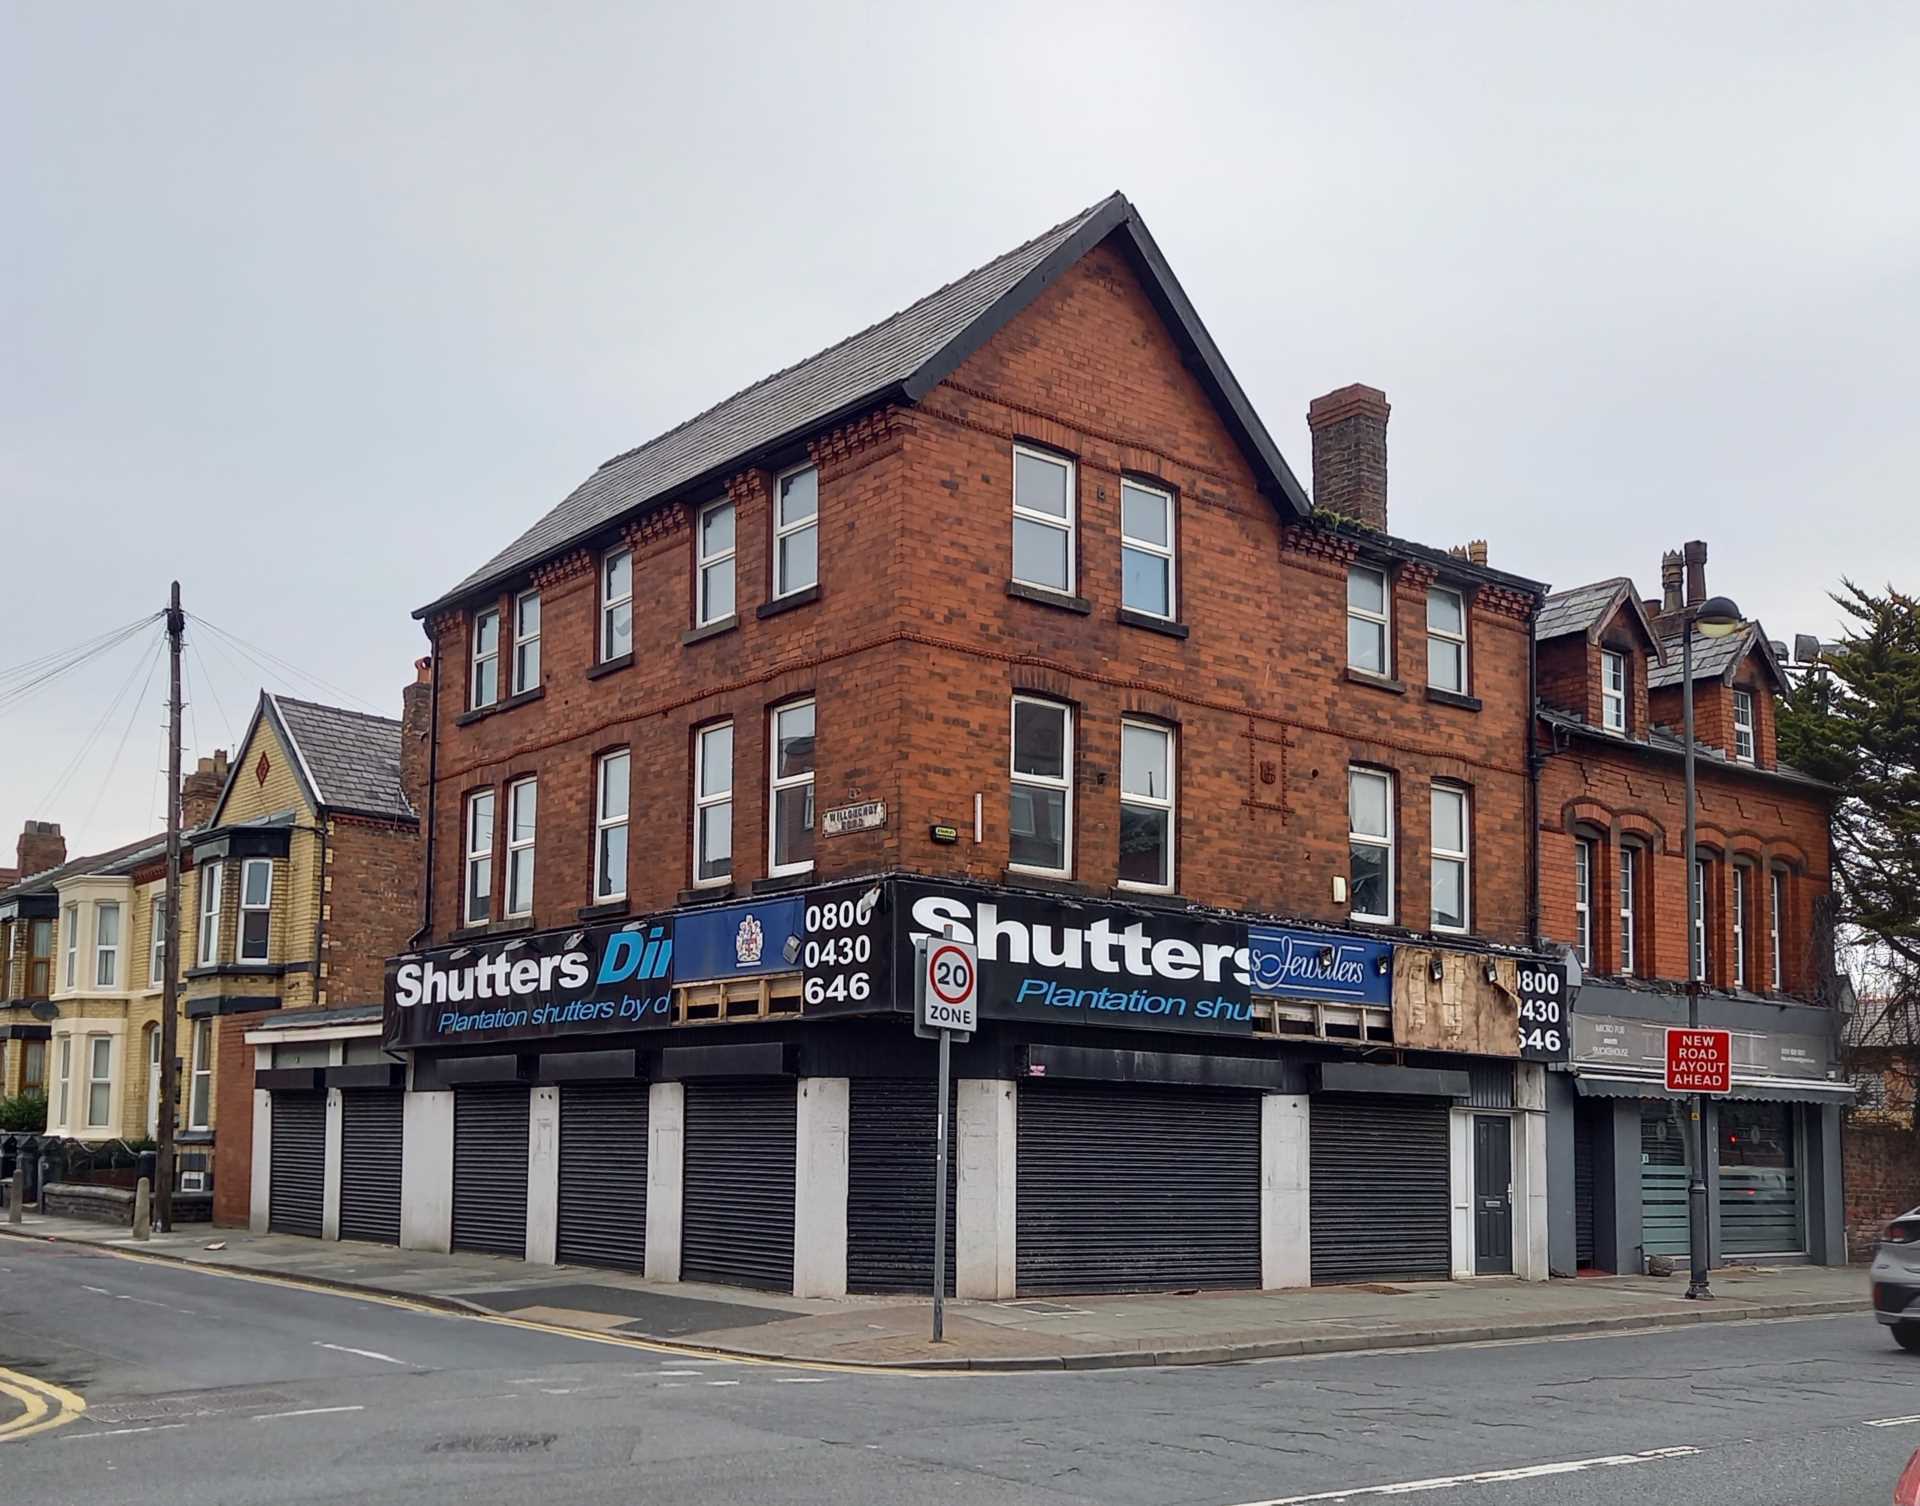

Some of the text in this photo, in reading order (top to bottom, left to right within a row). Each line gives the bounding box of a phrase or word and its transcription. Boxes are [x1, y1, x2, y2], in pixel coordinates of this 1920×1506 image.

[805, 900, 872, 933] 0800
[804, 934, 871, 968] 0430
[395, 951, 589, 1007] Shutters
[937, 961, 967, 988] 20
[804, 972, 870, 1005] 646
[1016, 978, 1185, 1017] Plantation
[438, 1008, 527, 1033] Plantation
[531, 1001, 615, 1025] shutters
[619, 994, 650, 1022] by
[930, 1005, 972, 1024] ZONE
[1517, 999, 1560, 1023] 430
[1679, 1047, 1718, 1060] ROAD
[1682, 1035, 1715, 1047] NEW
[1672, 1060, 1726, 1073] LAYOUT
[1673, 1073, 1722, 1086] AHEAD
